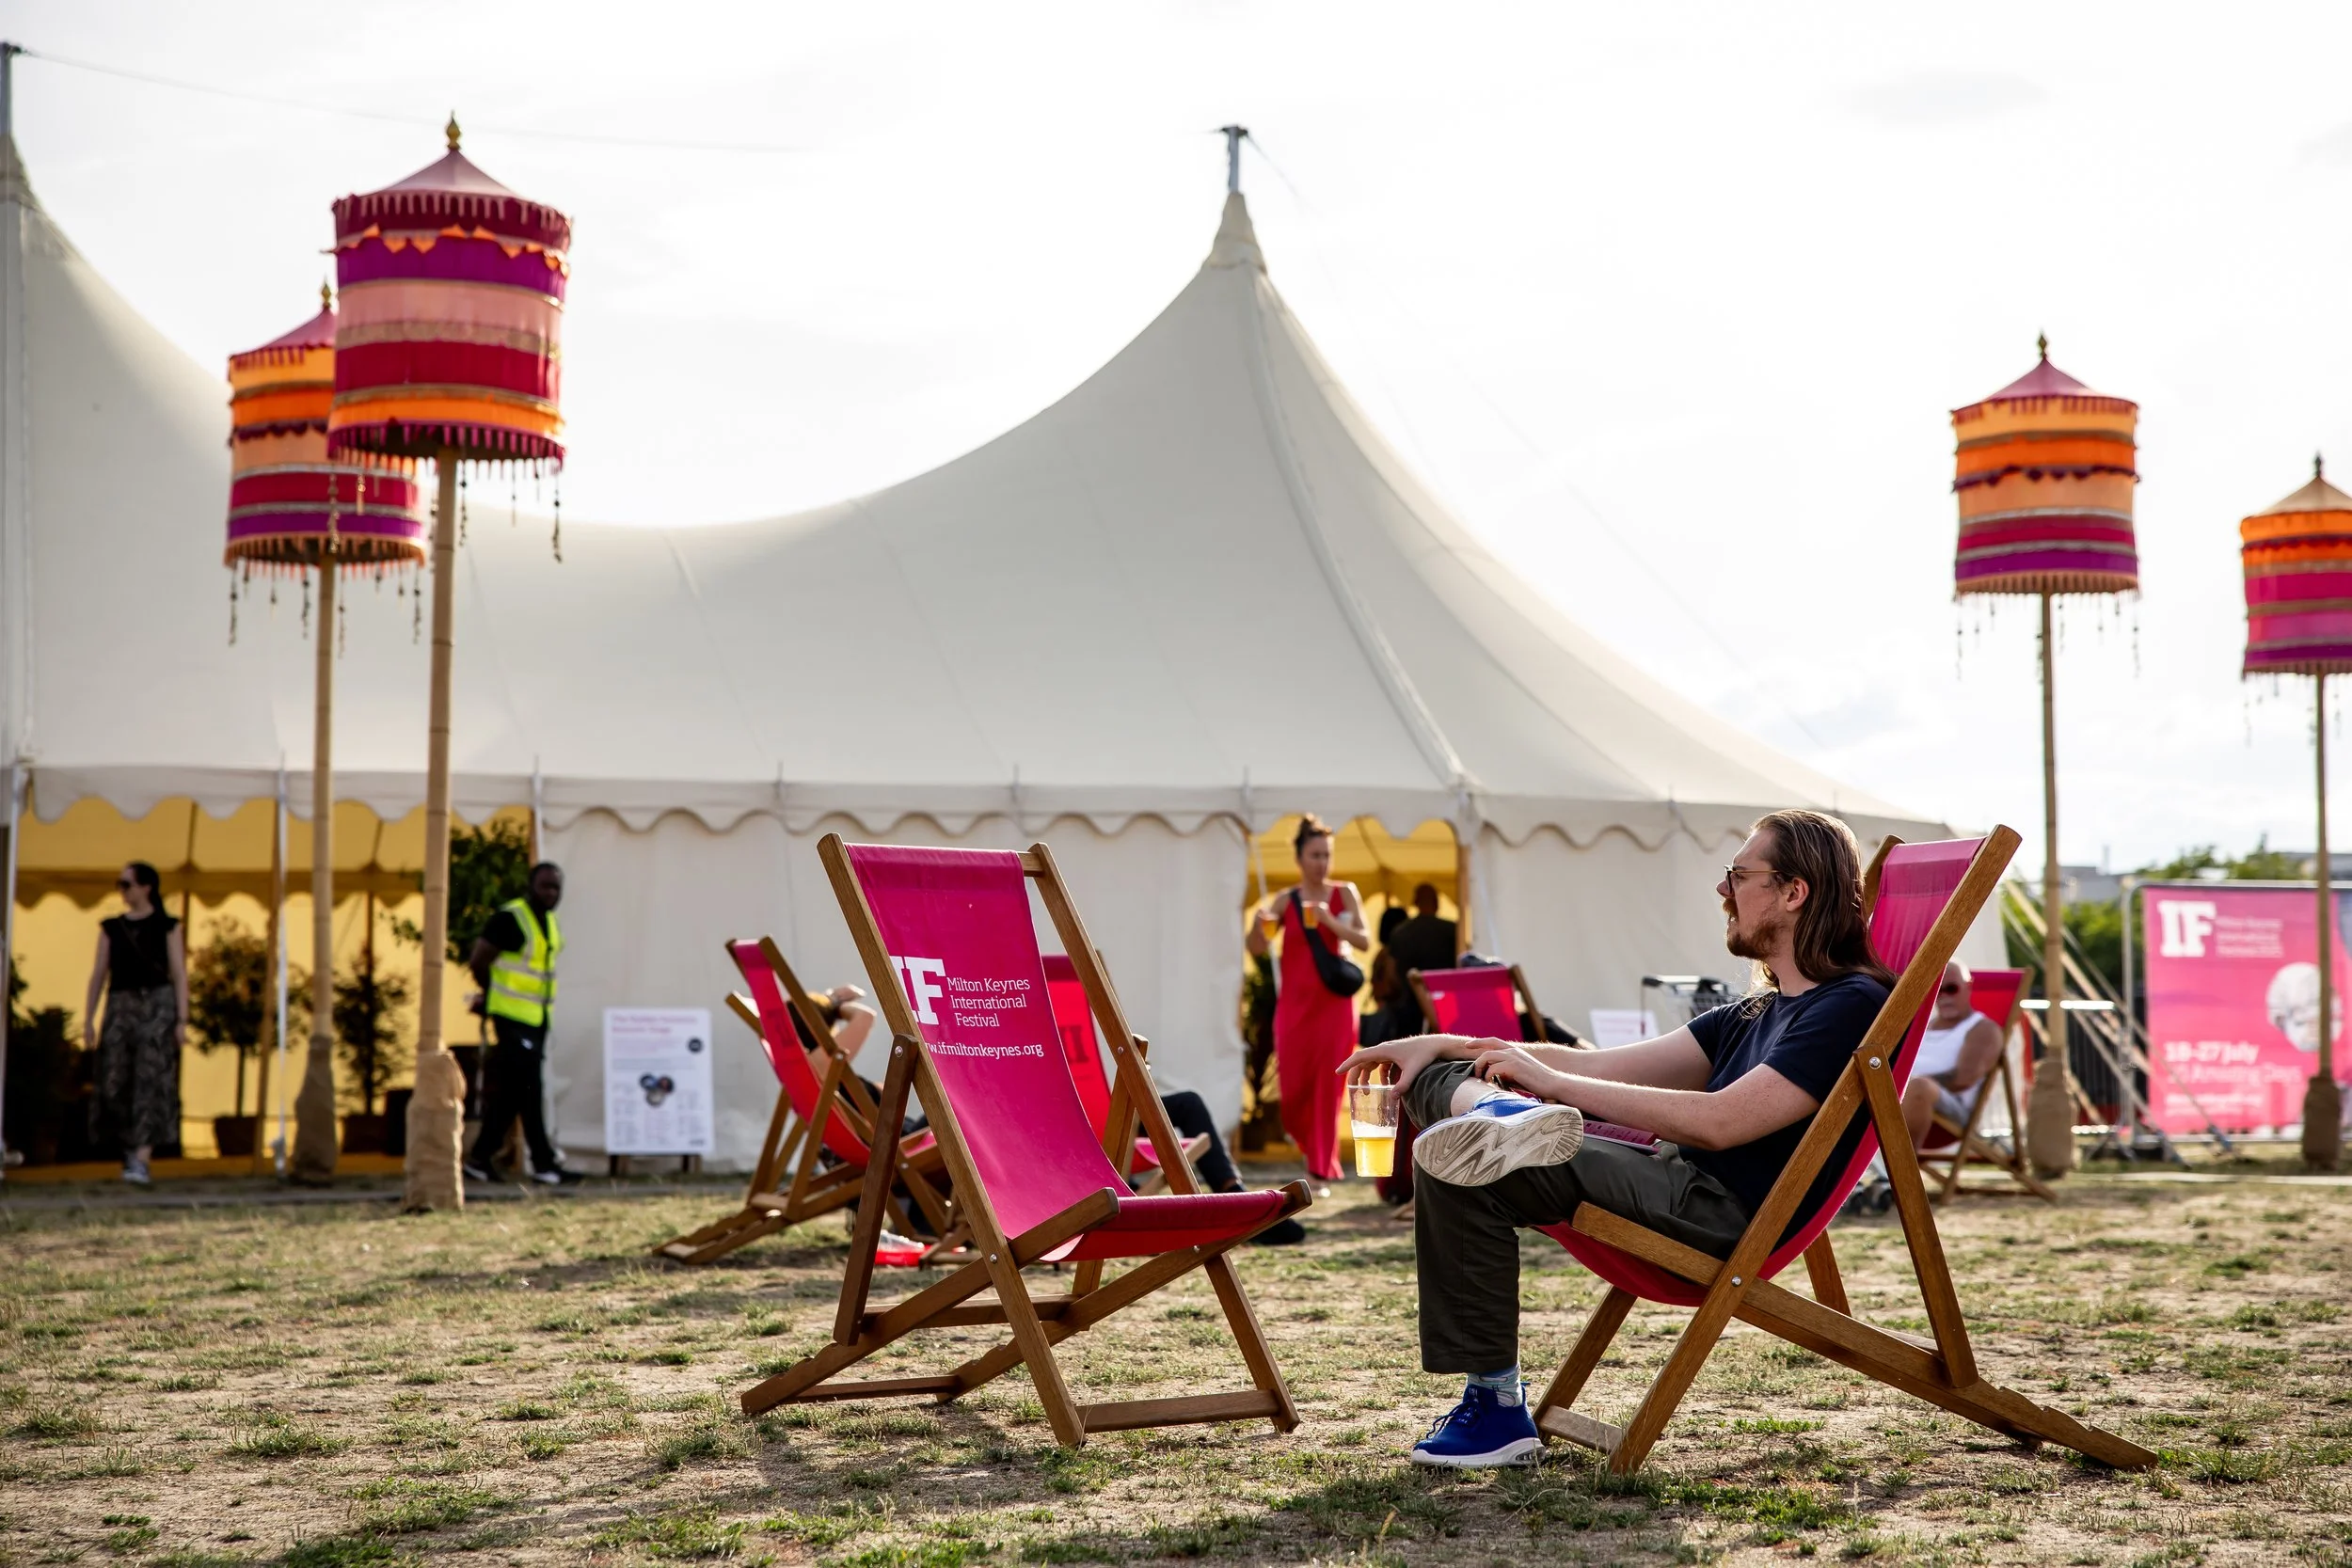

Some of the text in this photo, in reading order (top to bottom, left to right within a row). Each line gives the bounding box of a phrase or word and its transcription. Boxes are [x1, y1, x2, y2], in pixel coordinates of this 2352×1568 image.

[2156, 899, 2217, 958] IF
[946, 976, 1031, 994] Milton Keynes
[950, 993, 1027, 1010] International
[954, 1012, 1000, 1028] Festival
